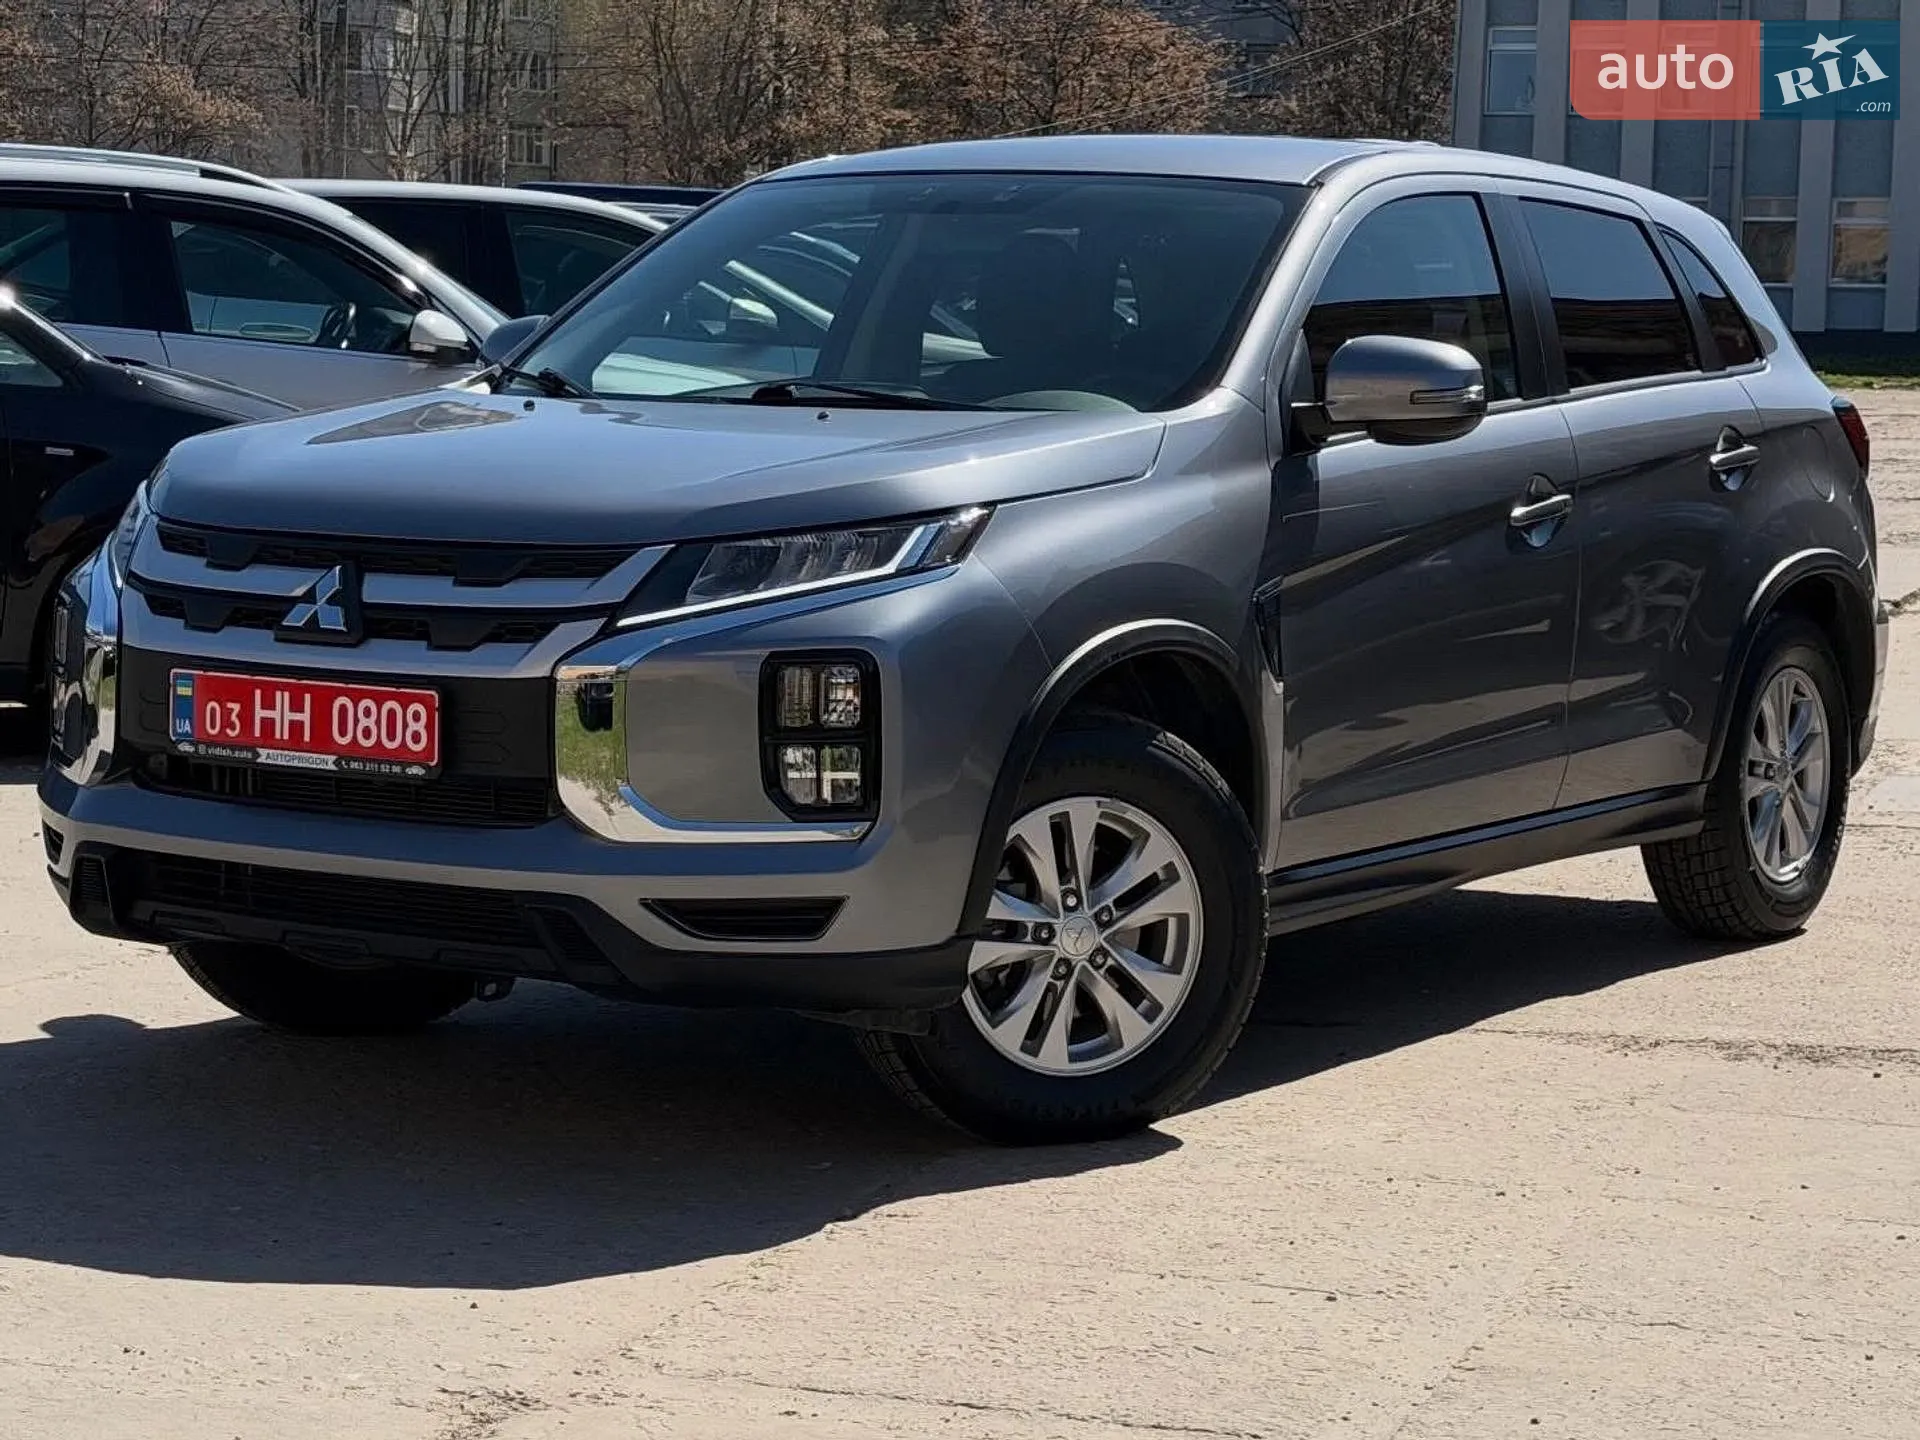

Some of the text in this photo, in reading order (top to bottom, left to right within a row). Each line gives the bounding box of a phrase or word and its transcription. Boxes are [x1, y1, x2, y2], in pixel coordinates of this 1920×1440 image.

[176, 719, 191, 734] UA
[205, 689, 428, 751] 03 HH 0808
